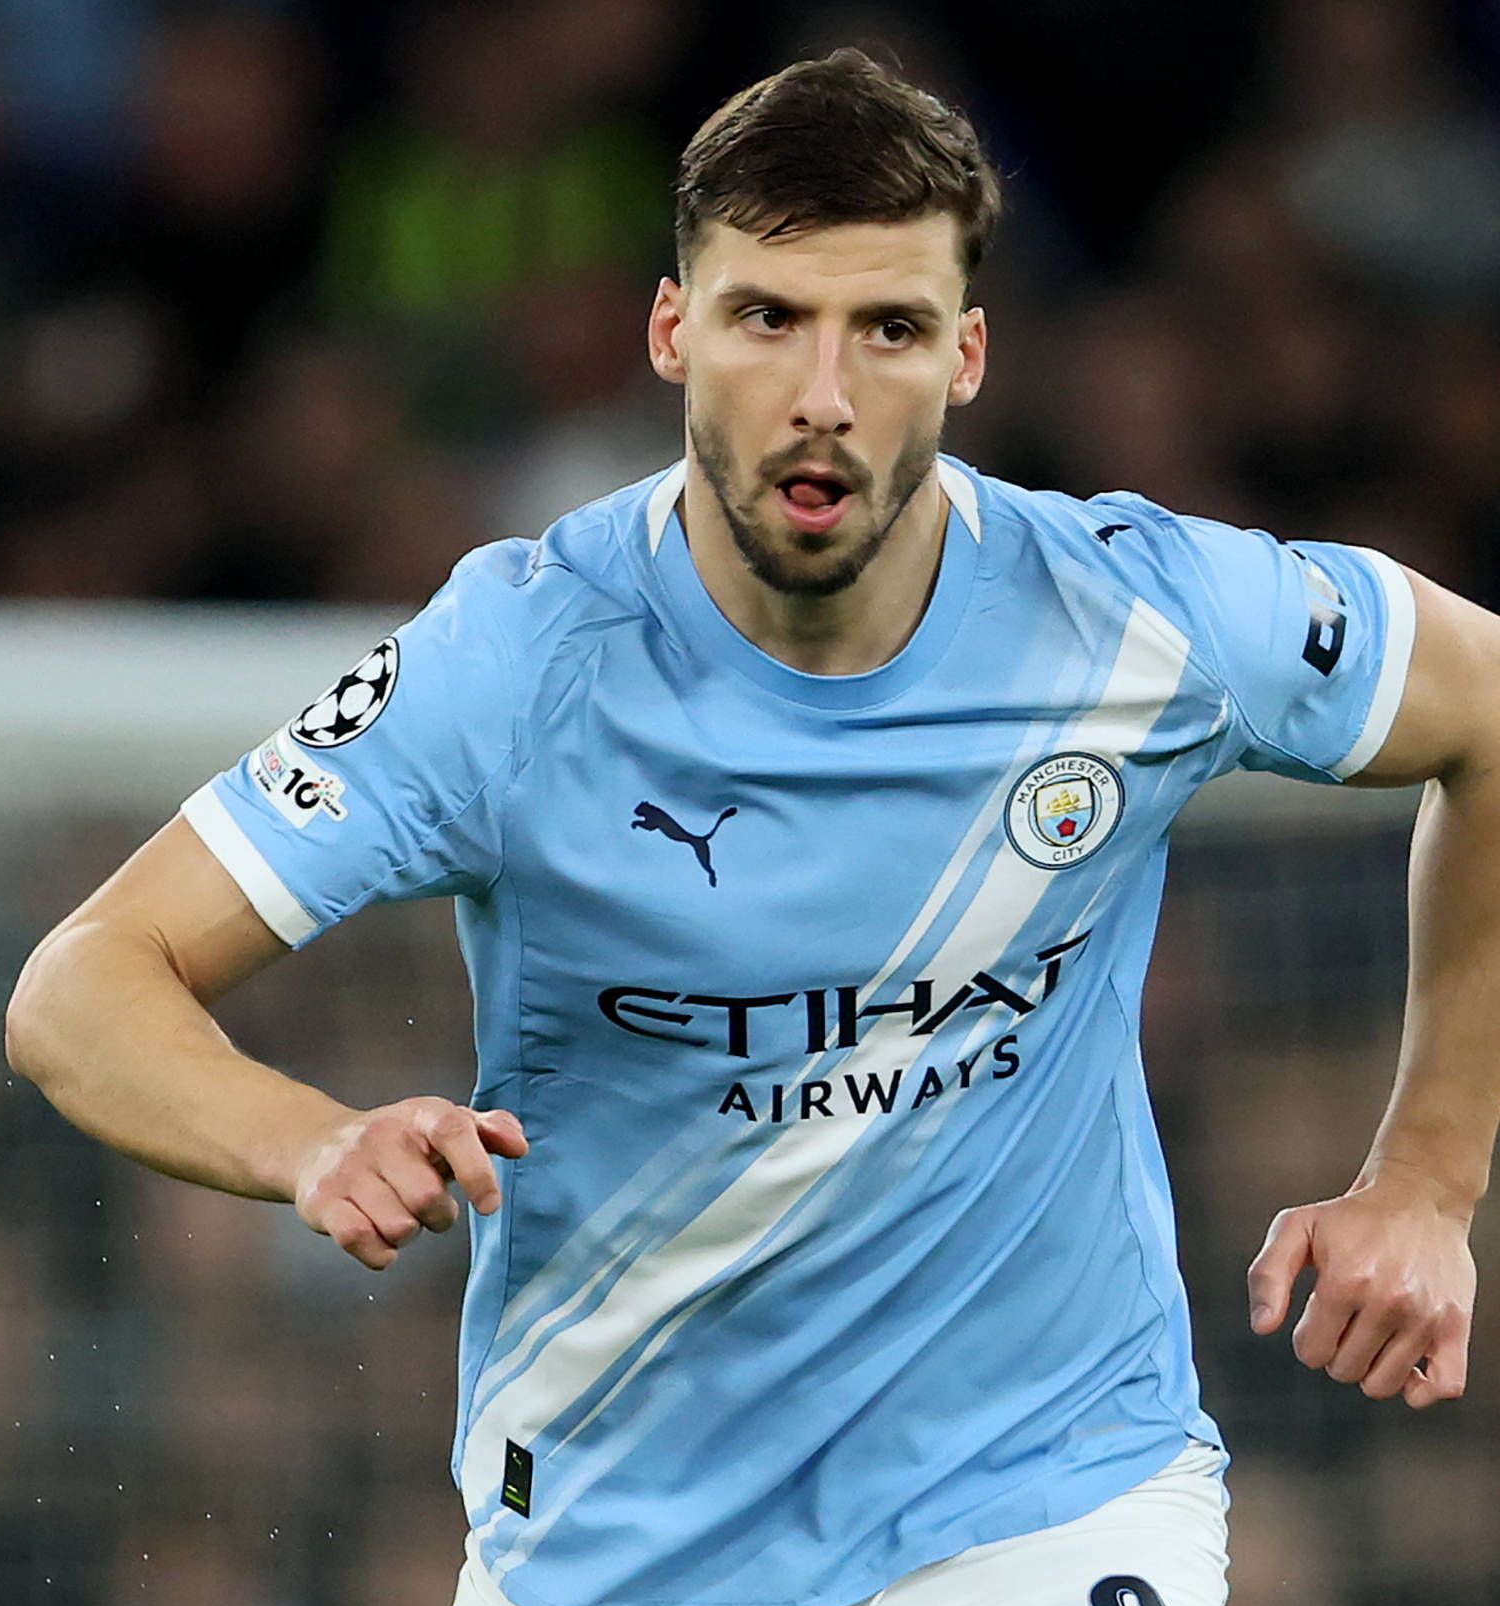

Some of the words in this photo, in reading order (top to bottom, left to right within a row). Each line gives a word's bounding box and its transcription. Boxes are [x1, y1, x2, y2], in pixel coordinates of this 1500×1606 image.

[283, 768, 321, 809] 10
[1018, 760, 1108, 803] MANCHESTER
[1053, 845, 1084, 861] CITY
[718, 1034, 1020, 1123] AIRWAYS
